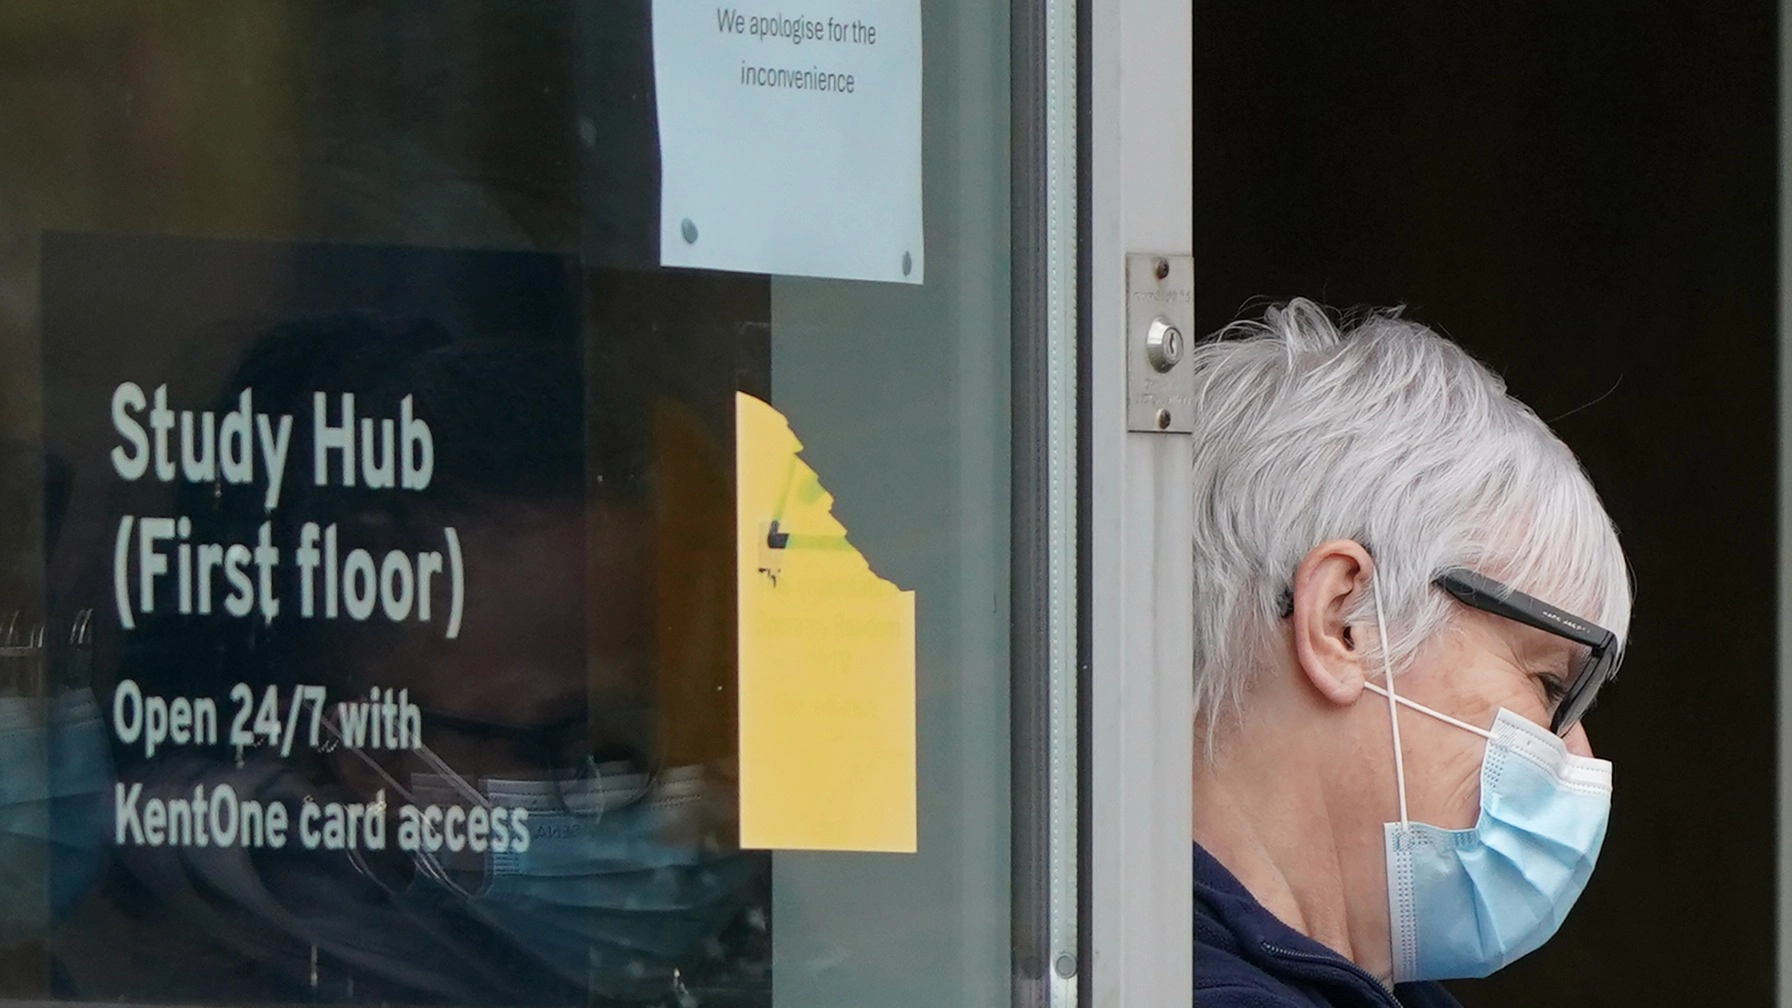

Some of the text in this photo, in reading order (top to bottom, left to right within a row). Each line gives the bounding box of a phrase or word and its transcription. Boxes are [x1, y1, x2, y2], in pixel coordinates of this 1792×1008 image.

[717, 8, 876, 45] We apologise for the
[740, 60, 855, 93] inconvenience
[111, 381, 434, 512] Study Hub
[114, 515, 464, 638] (First floor)
[113, 679, 422, 759] Open 24/7 with
[114, 782, 531, 853] KentOne card access
